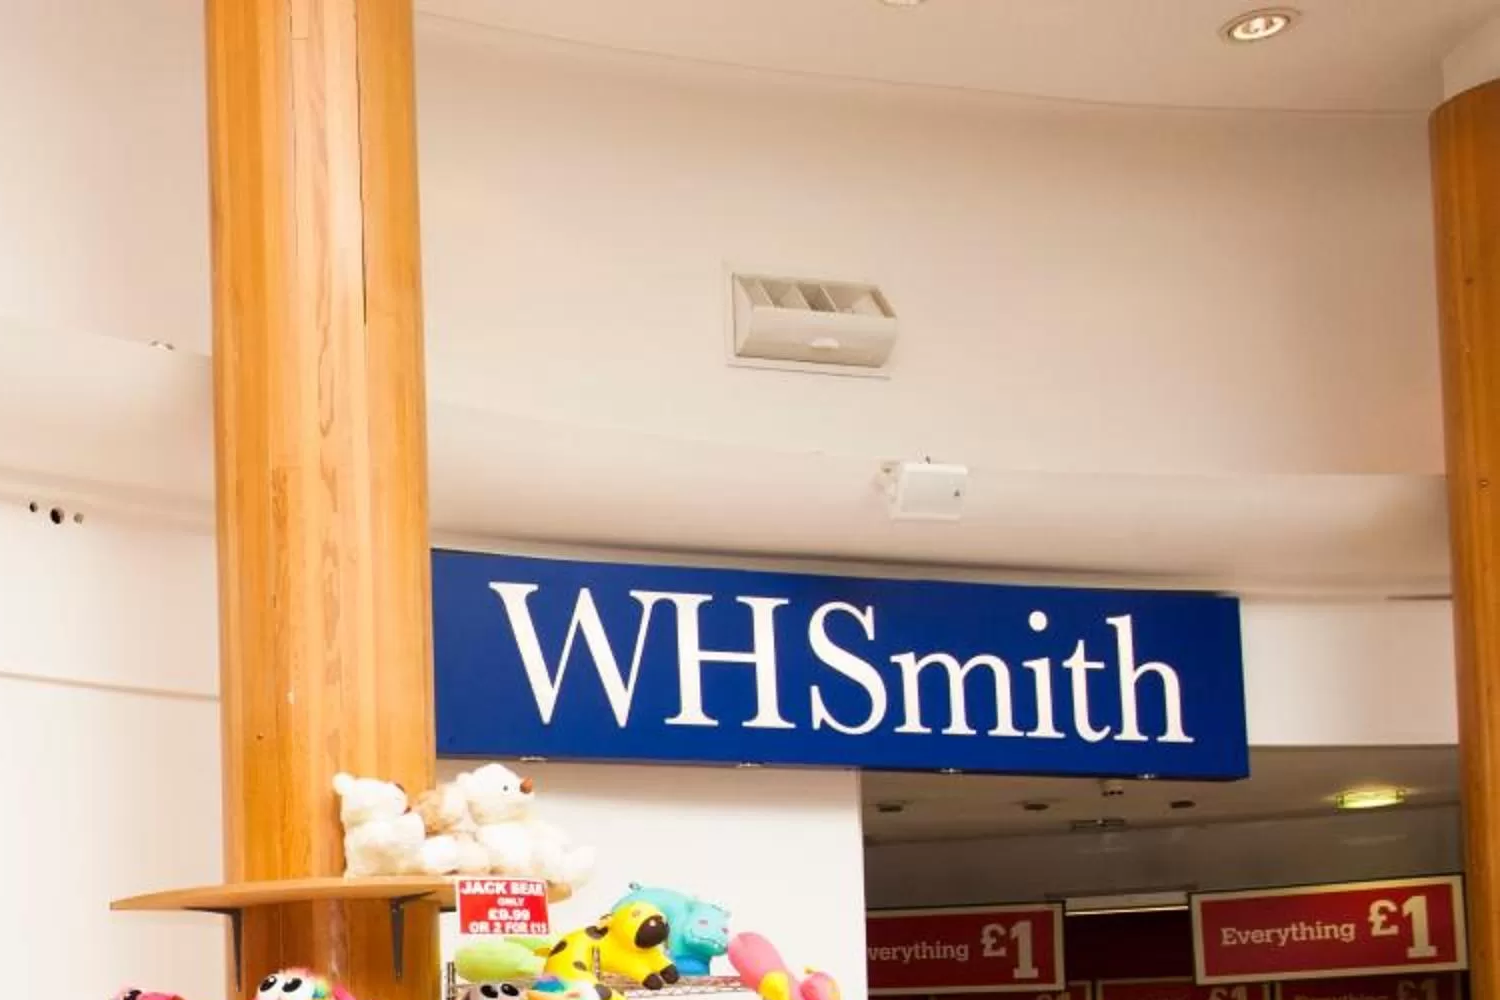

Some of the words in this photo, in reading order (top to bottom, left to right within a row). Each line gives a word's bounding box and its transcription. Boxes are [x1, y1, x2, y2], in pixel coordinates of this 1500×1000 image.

[488, 580, 1195, 748] WHSmith
[461, 880, 508, 895] JACK
[868, 940, 970, 964] verything
[981, 920, 1040, 980] £1
[1220, 920, 1356, 947] Everything
[1368, 895, 1438, 959] £1
